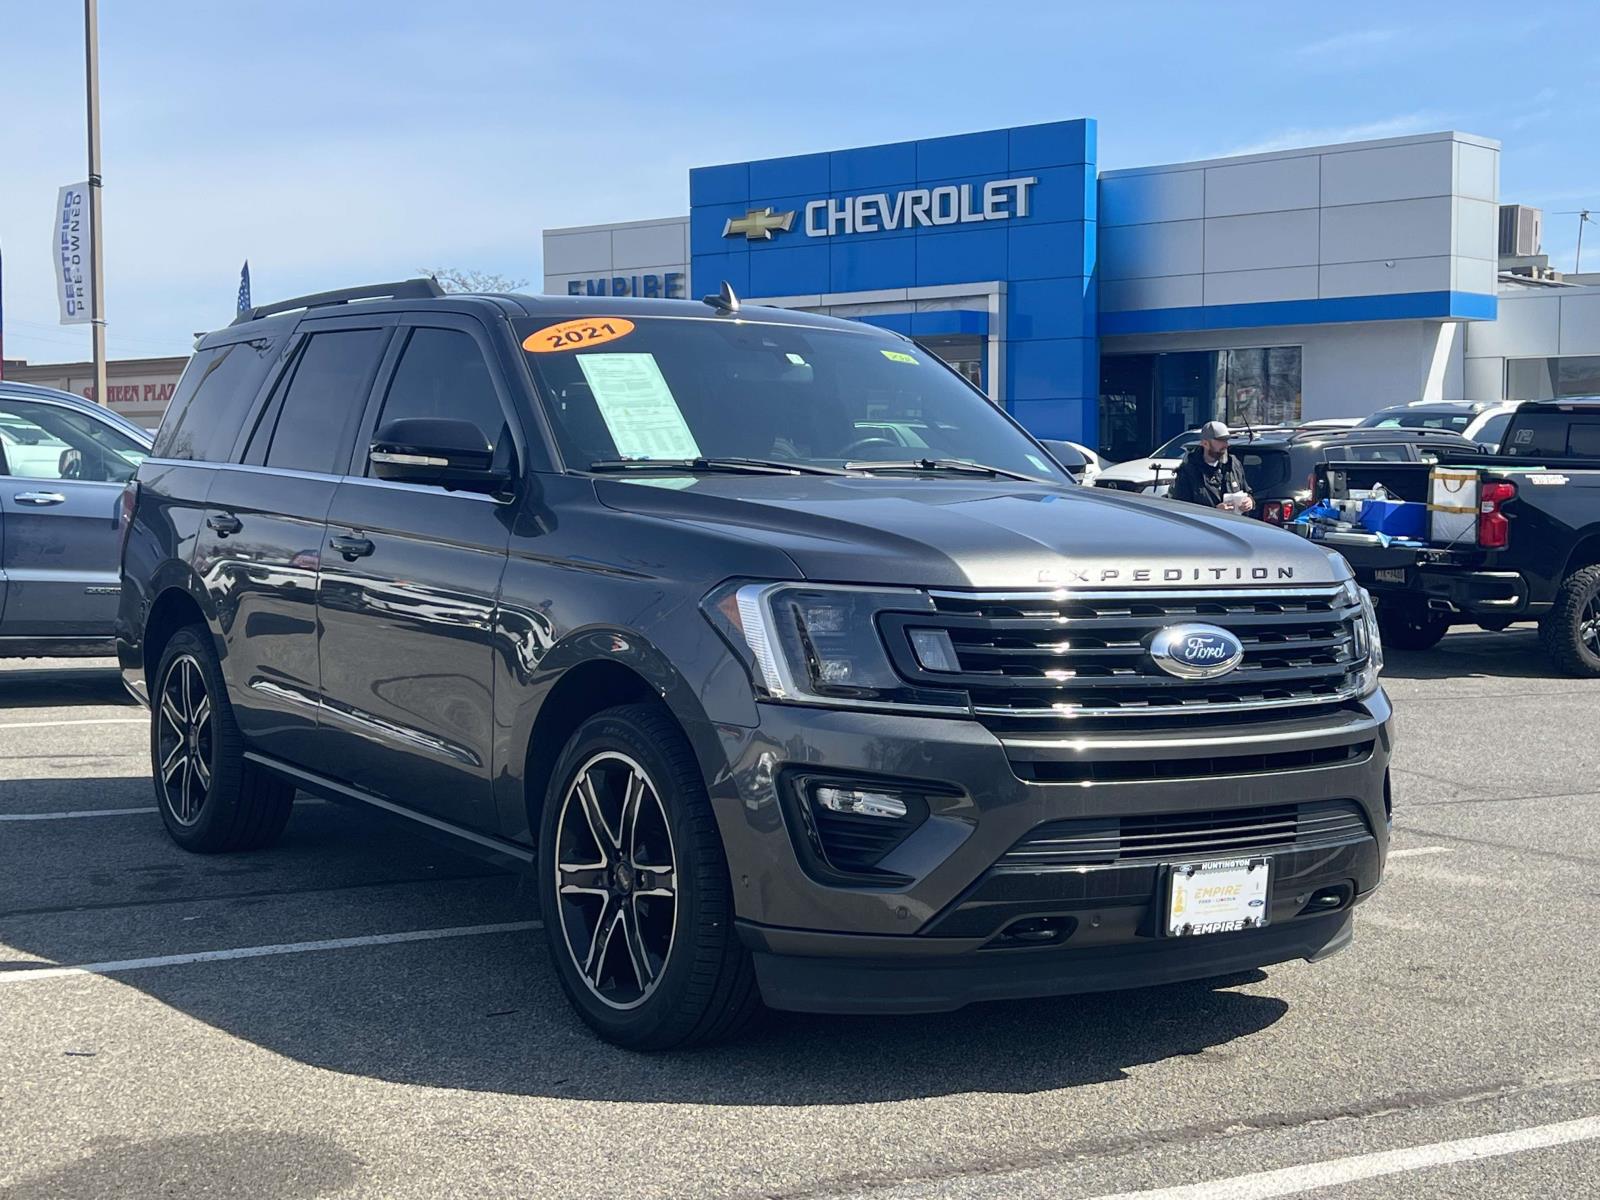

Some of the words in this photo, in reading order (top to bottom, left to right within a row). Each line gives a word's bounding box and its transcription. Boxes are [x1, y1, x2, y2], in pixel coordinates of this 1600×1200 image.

[804, 176, 1037, 238] CHEVROLET
[61, 191, 75, 316] CERTIFIED
[71, 194, 84, 311] PRE-OWNED
[568, 273, 684, 300] EMPIRE
[546, 323, 616, 348] 2021
[83, 385, 139, 402] SHEEN
[143, 383, 177, 401] PLAZ
[1037, 567, 1294, 583] EXPEDITION
[1184, 637, 1226, 660] Ford
[1201, 859, 1251, 871] HUNTINGTON
[1194, 884, 1243, 899] EMPIRE
[1192, 920, 1245, 935] EMPIRE
